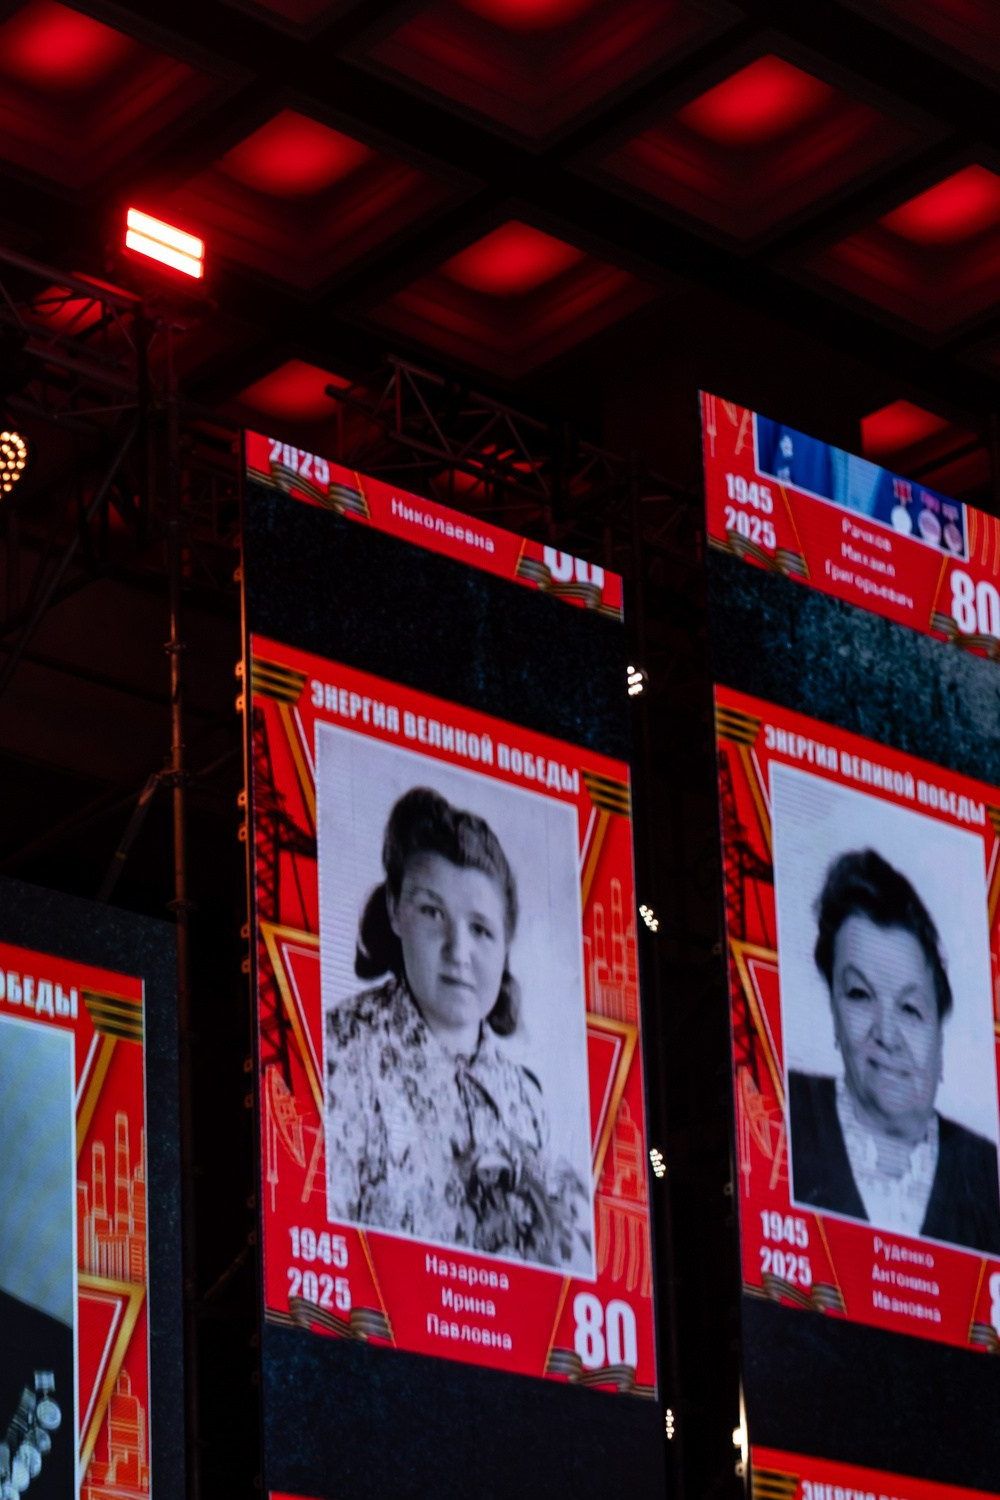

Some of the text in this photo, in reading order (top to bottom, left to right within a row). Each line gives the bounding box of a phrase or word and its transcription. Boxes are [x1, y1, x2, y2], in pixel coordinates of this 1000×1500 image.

[726, 473, 774, 515] 1945
[392, 498, 495, 553] Николаевна
[725, 506, 777, 550] 2025
[825, 559, 914, 609] Григорьевич
[951, 569, 1000, 639] 80
[311, 680, 579, 794] ЭНЕРГИЯ ВЕЛИКОЙ ПОБЕДЫ
[765, 724, 985, 826] ЭНЕРГИЯ ВЕЛИКОЙ ПОБЕДЫ
[288, 1226, 348, 1268] 1945
[760, 1210, 809, 1249] 1945
[426, 1254, 510, 1290] Назарова
[760, 1246, 813, 1287] 2025
[873, 1236, 935, 1269] Руденко
[287, 1267, 352, 1312] 2025
[871, 1264, 940, 1297] Антонина
[441, 1288, 497, 1317] Ирина
[872, 1290, 942, 1323] Ивановна
[427, 1314, 513, 1350] Павловна
[573, 1292, 637, 1371] 80
